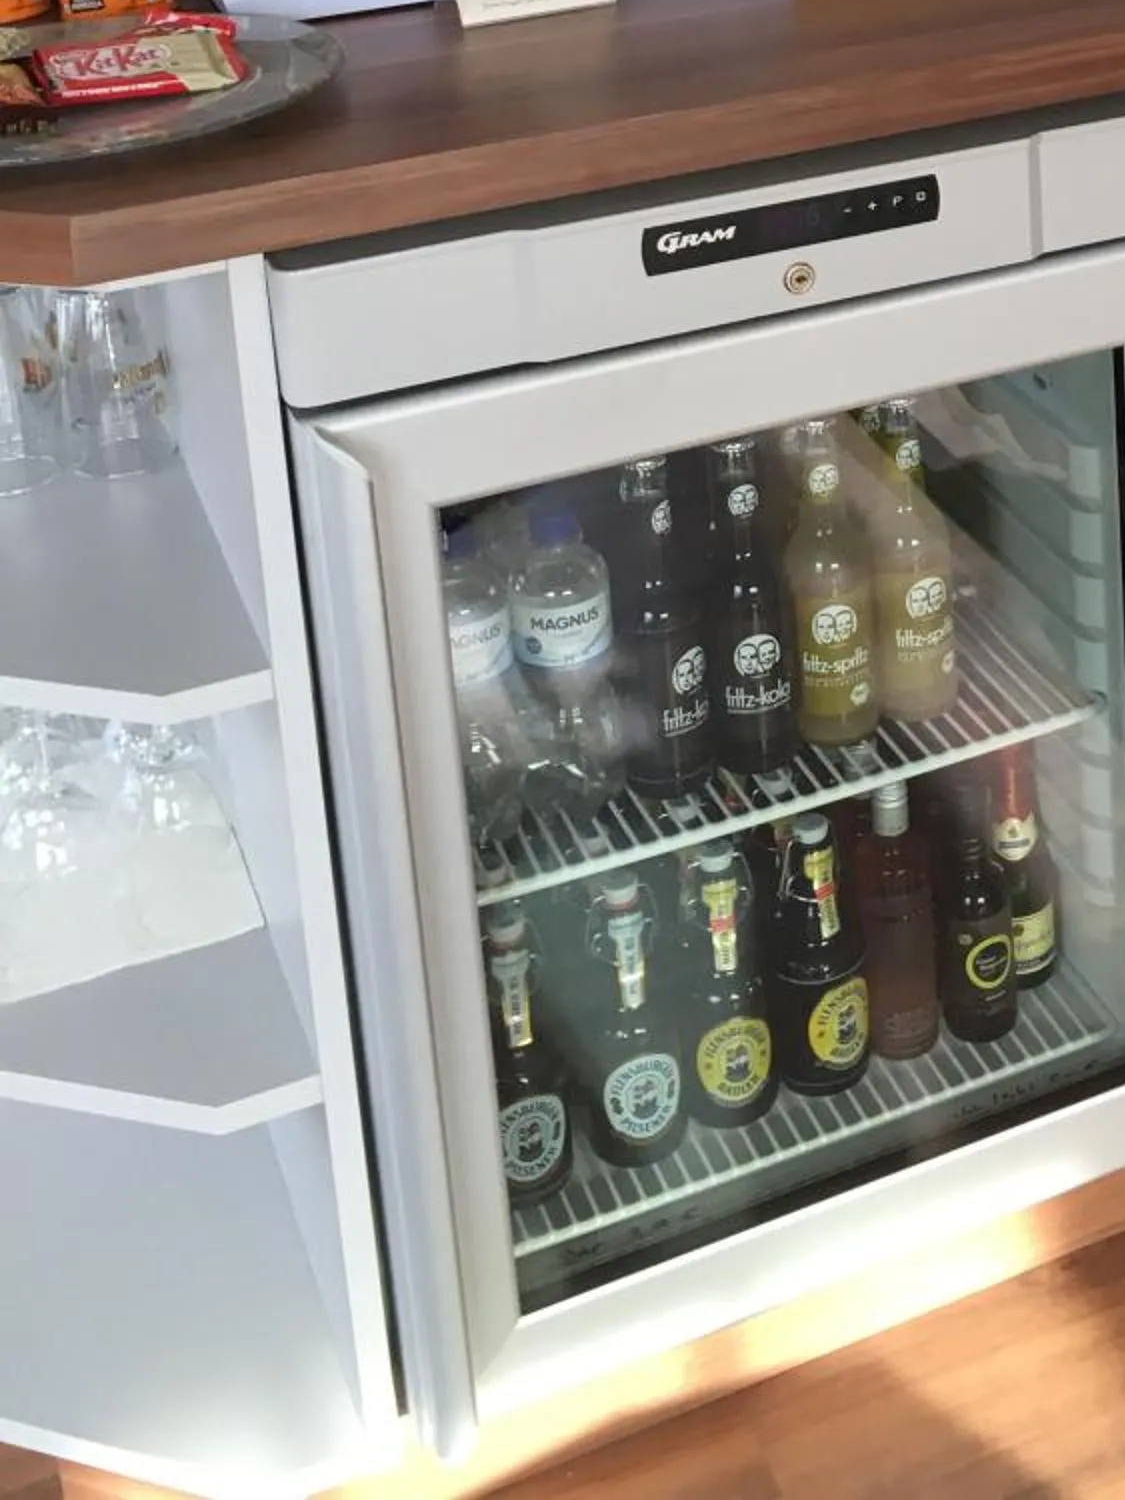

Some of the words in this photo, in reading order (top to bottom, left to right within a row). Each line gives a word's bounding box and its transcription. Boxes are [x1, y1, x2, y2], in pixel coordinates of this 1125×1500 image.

[657, 226, 736, 253] GRAM
[530, 607, 599, 630] MAGNUS
[725, 680, 791, 708] fritz-kola
